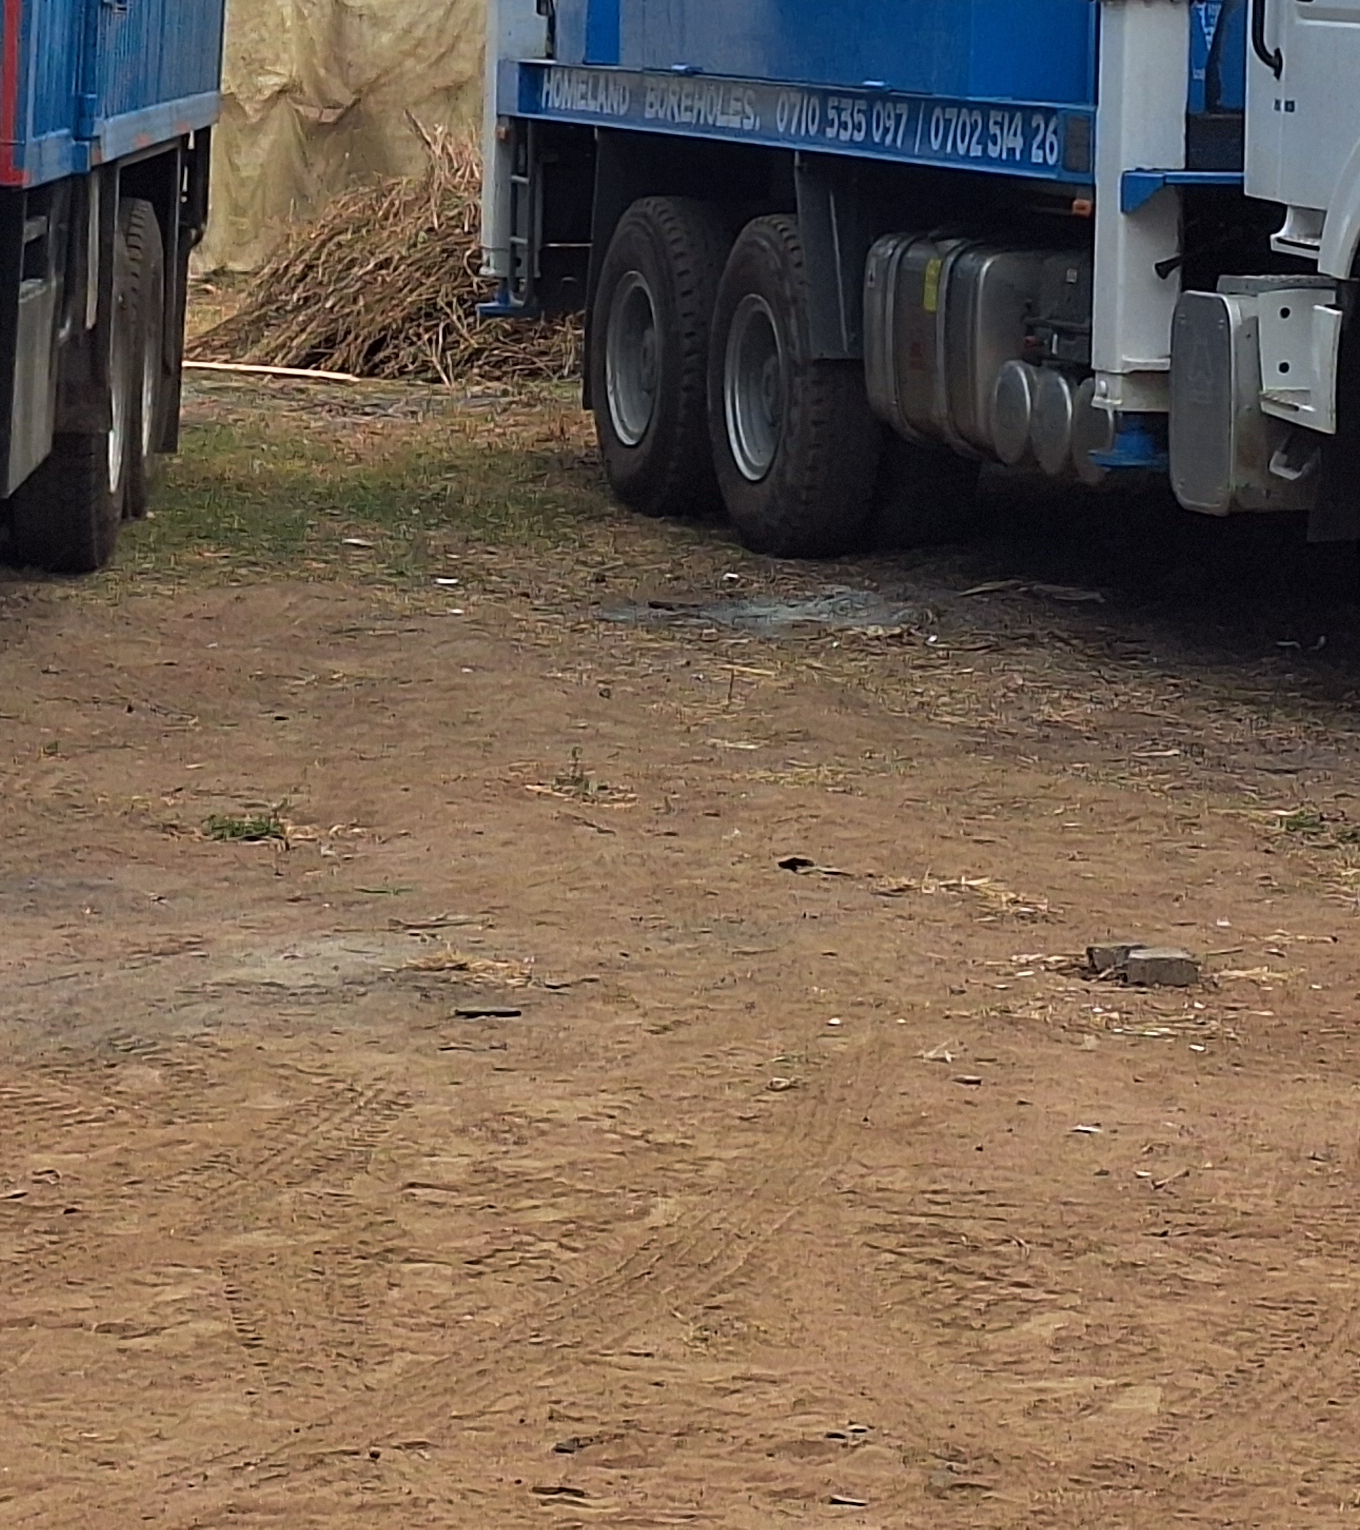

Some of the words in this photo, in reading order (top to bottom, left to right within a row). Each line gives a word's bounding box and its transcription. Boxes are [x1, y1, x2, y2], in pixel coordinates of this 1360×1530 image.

[542, 70, 630, 116] HOMELAND
[776, 92, 819, 137] 0710
[872, 101, 909, 149] 097
[930, 108, 983, 157] 0702
[987, 111, 1024, 160] 514
